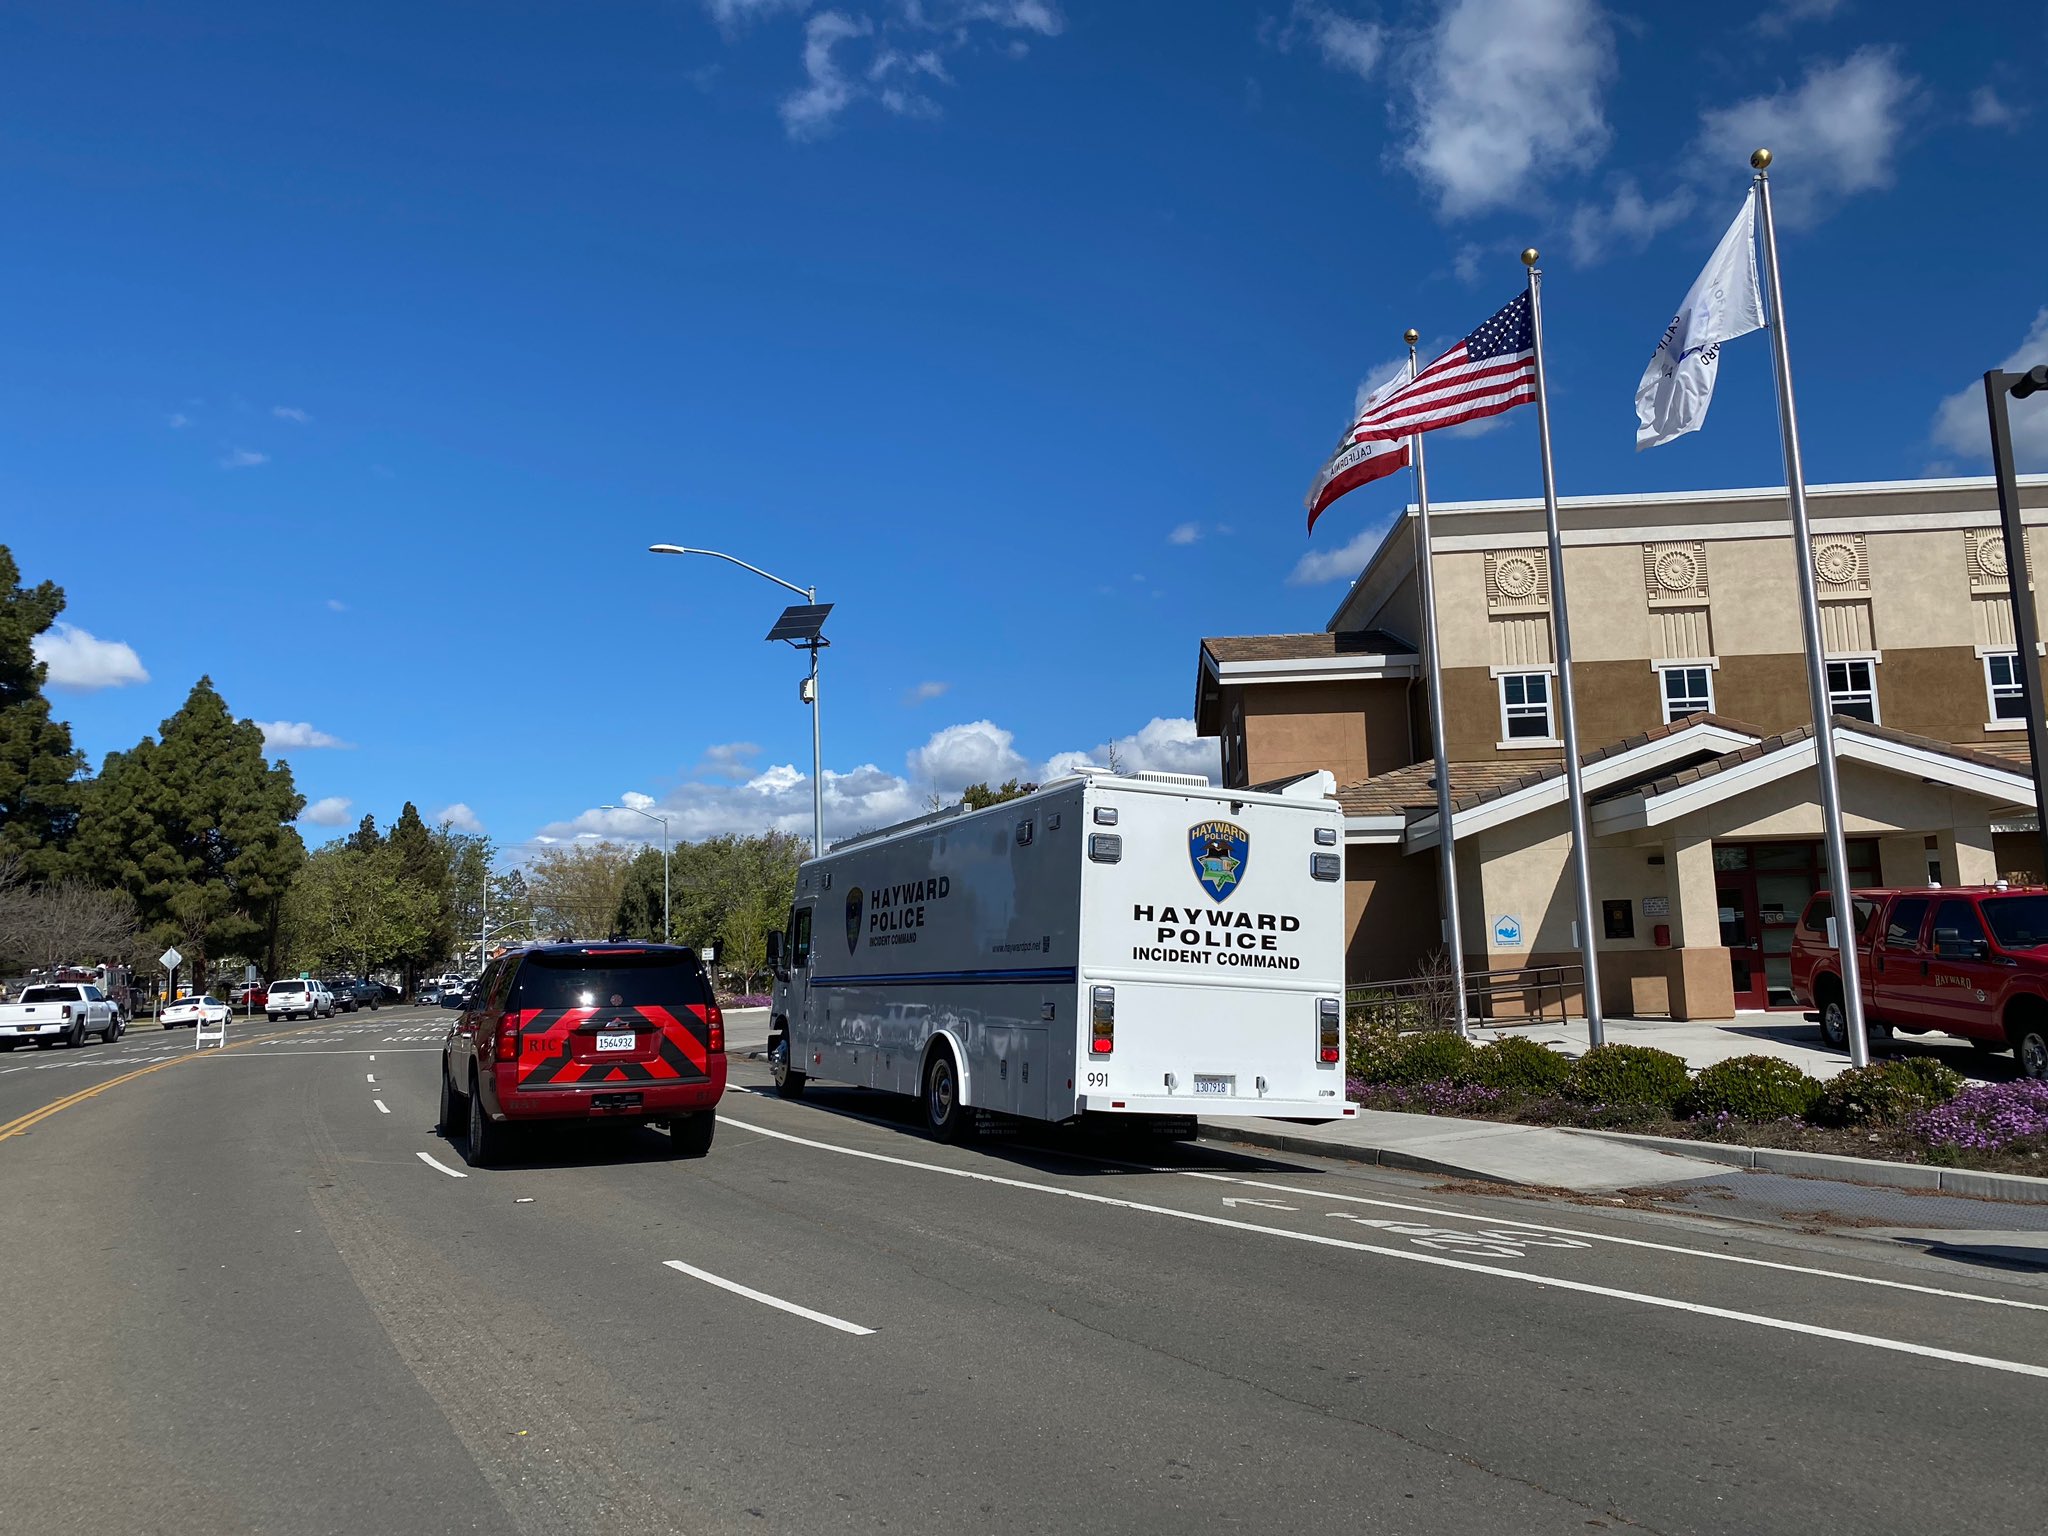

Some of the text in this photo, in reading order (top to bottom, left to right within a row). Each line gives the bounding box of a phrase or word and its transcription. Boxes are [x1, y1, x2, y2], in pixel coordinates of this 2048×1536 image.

[1192, 822, 1246, 843] HAYWARD
[1204, 832, 1234, 844] POLICE
[871, 876, 950, 910] HAYWARD
[870, 906, 925, 933] POLICE
[1133, 904, 1301, 932] HAYWARD
[869, 932, 917, 947] INCIDENT COMMAND
[1157, 927, 1278, 951] POLICE
[1133, 947, 1300, 970] INCIDENT COMMAND
[1935, 974, 1971, 990] HAYWARD
[599, 1037, 633, 1049] 1564932
[1087, 1072, 1108, 1087] 991
[1195, 1082, 1226, 1093] 1307918
